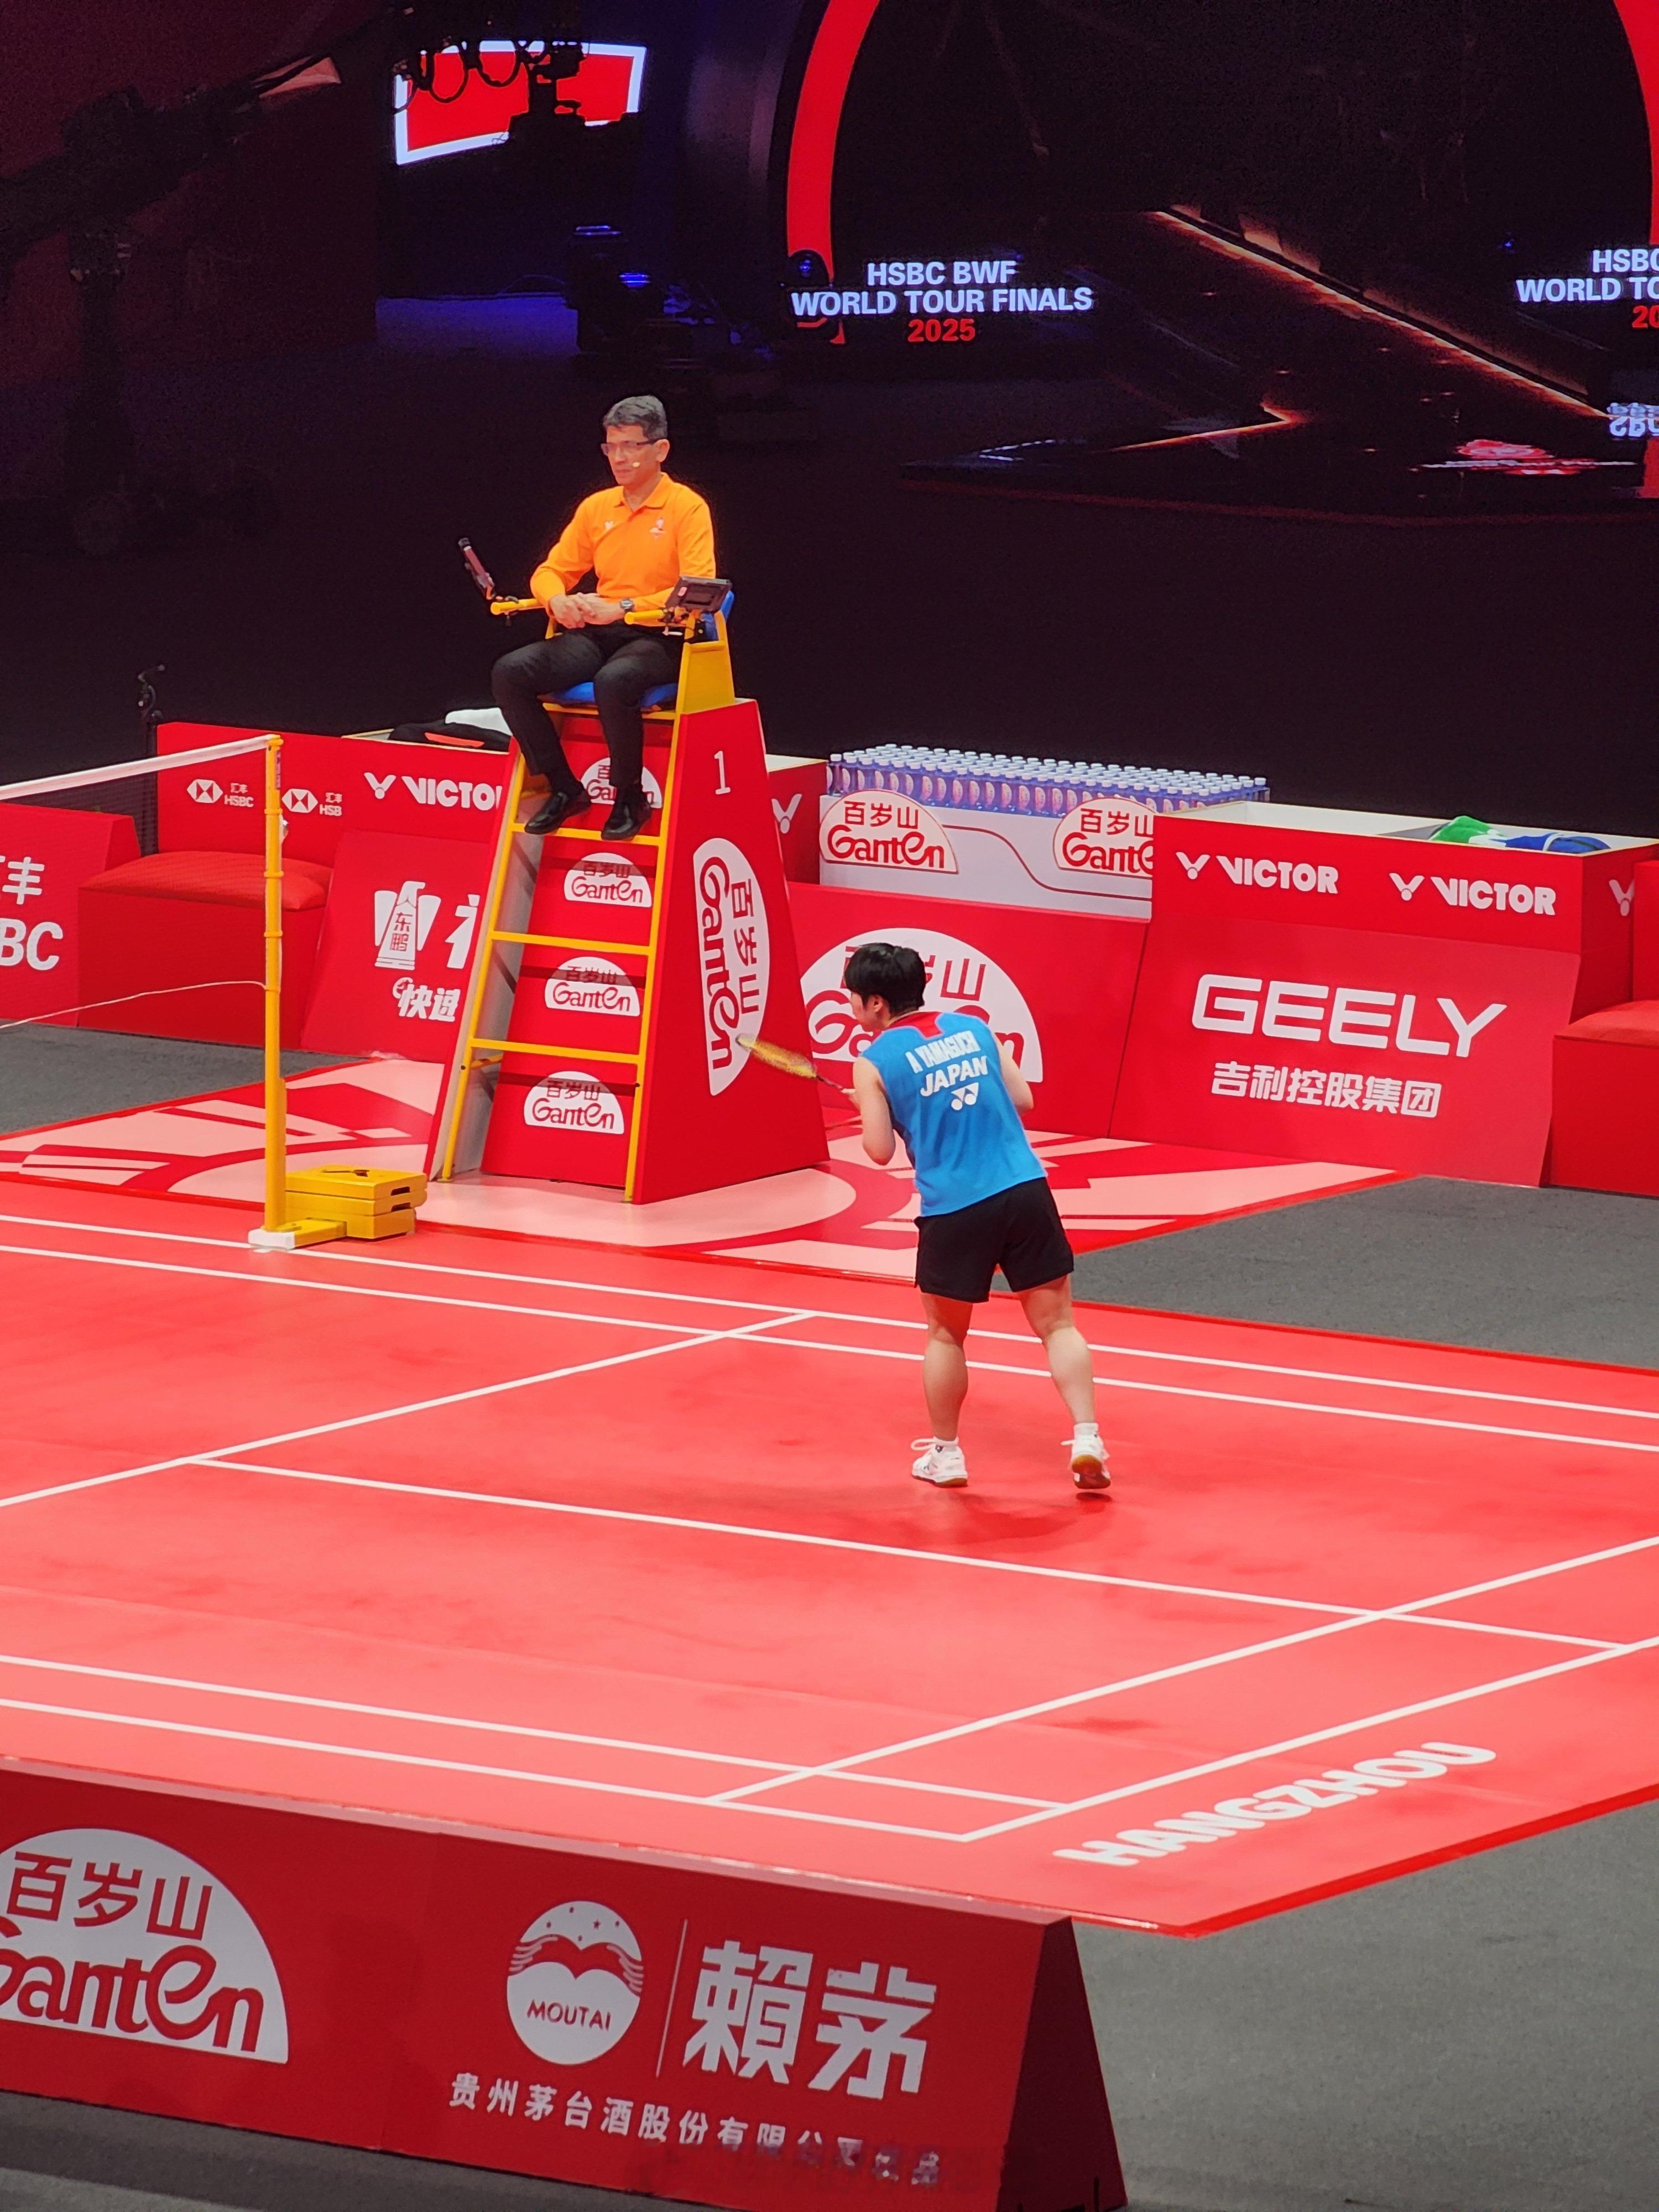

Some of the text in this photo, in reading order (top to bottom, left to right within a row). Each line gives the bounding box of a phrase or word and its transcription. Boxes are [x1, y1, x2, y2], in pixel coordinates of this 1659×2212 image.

[868, 260, 1017, 286] HSBC BWF
[1516, 278, 1621, 302] WORLD
[791, 287, 1093, 316] WORLD TOUR FINALS
[907, 319, 975, 342] 2025
[714, 750, 731, 795] 1
[224, 795, 254, 807] HSBC
[401, 776, 503, 811] VICTO
[844, 800, 919, 830] 百岁山
[0, 855, 45, 905] 丰
[1216, 855, 1338, 895] VICTOR
[1431, 876, 1556, 916] VICTOR
[731, 878, 759, 1015] 百岁山
[1192, 973, 1507, 1058] GEELY
[546, 1079, 601, 1101] 百岁山
[920, 1055, 988, 1097] JAPAN
[1212, 1061, 1442, 1119] 吉利控股集团
[1052, 1741, 1497, 1866] HANGZHOU
[6, 1851, 213, 1941] 百岁山
[527, 1999, 611, 2031] MOUTAI
